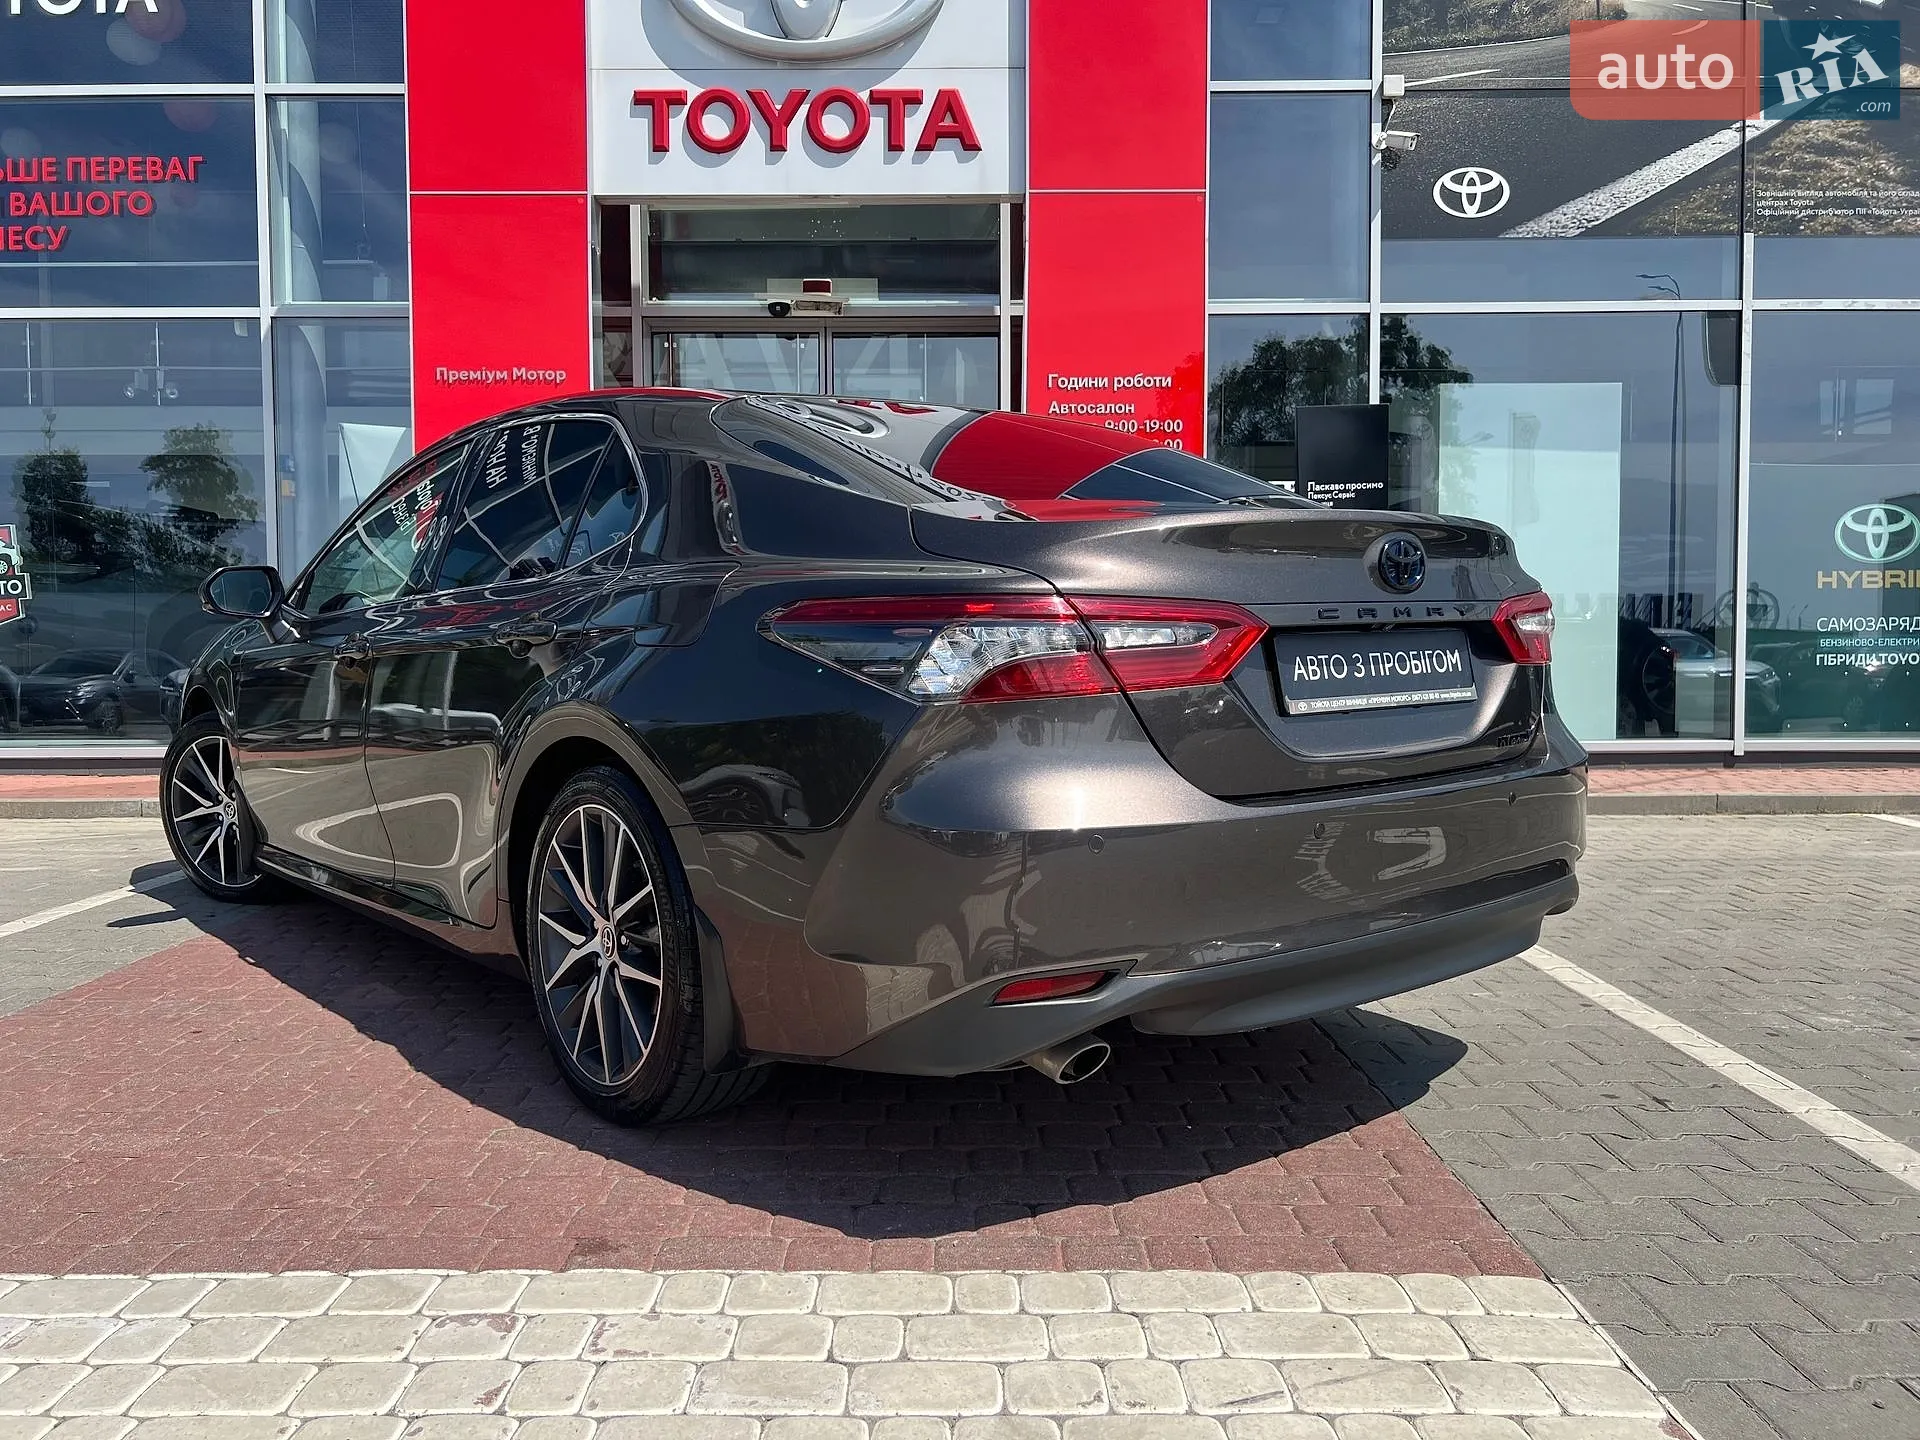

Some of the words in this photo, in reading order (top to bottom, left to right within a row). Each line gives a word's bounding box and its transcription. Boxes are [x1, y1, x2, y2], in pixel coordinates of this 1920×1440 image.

[633, 86, 983, 154] TOYOTA
[66, 156, 203, 182] ПЕРЕВАГ
[9, 190, 153, 216] ВАШОГО
[1789, 199, 1814, 207] Toyota
[1756, 208, 1800, 216] Офіційний
[436, 366, 508, 384] Преміум
[512, 366, 567, 384] Мотор
[1048, 374, 1108, 391] Години
[1113, 373, 1172, 391] роботи
[1048, 400, 1135, 414] Автосалон
[1346, 482, 1384, 491] просимо
[1317, 606, 1468, 620] CAMRY
[1820, 638, 1920, 647] БЕНЗИНОВО-ЕЛЕКТРИ
[1294, 653, 1348, 681] АВТО
[1368, 649, 1463, 677] ПРОБІГОМ
